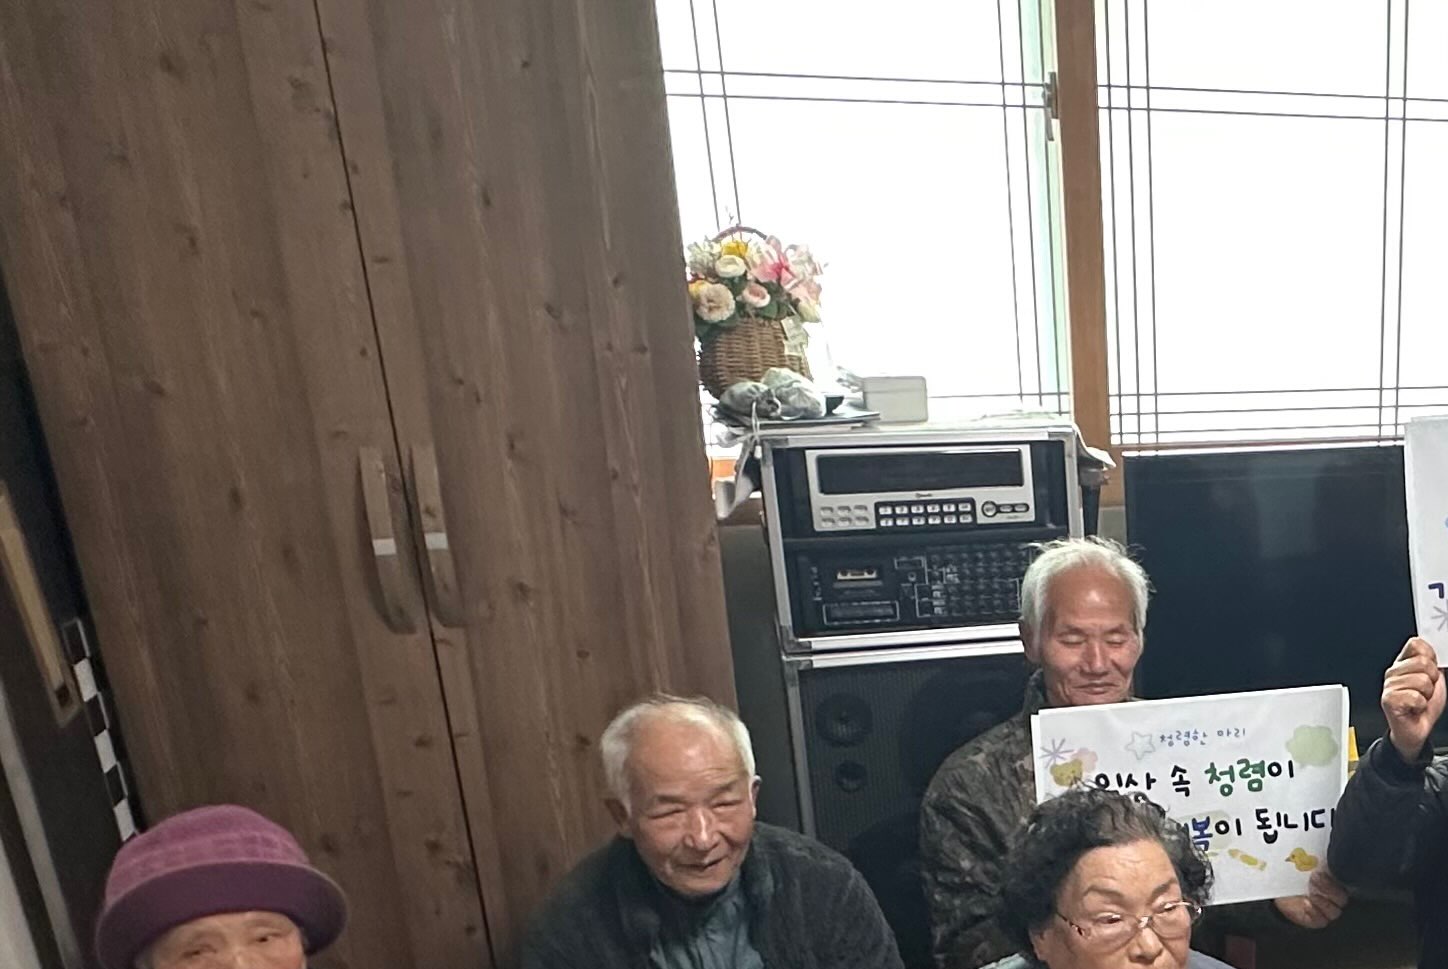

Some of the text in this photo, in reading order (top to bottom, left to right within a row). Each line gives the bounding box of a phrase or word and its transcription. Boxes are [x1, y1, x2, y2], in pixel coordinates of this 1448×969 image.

[1217, 728, 1246, 738] 마리
[1171, 764, 1191, 797] 속
[1205, 758, 1294, 797] 청렴이
